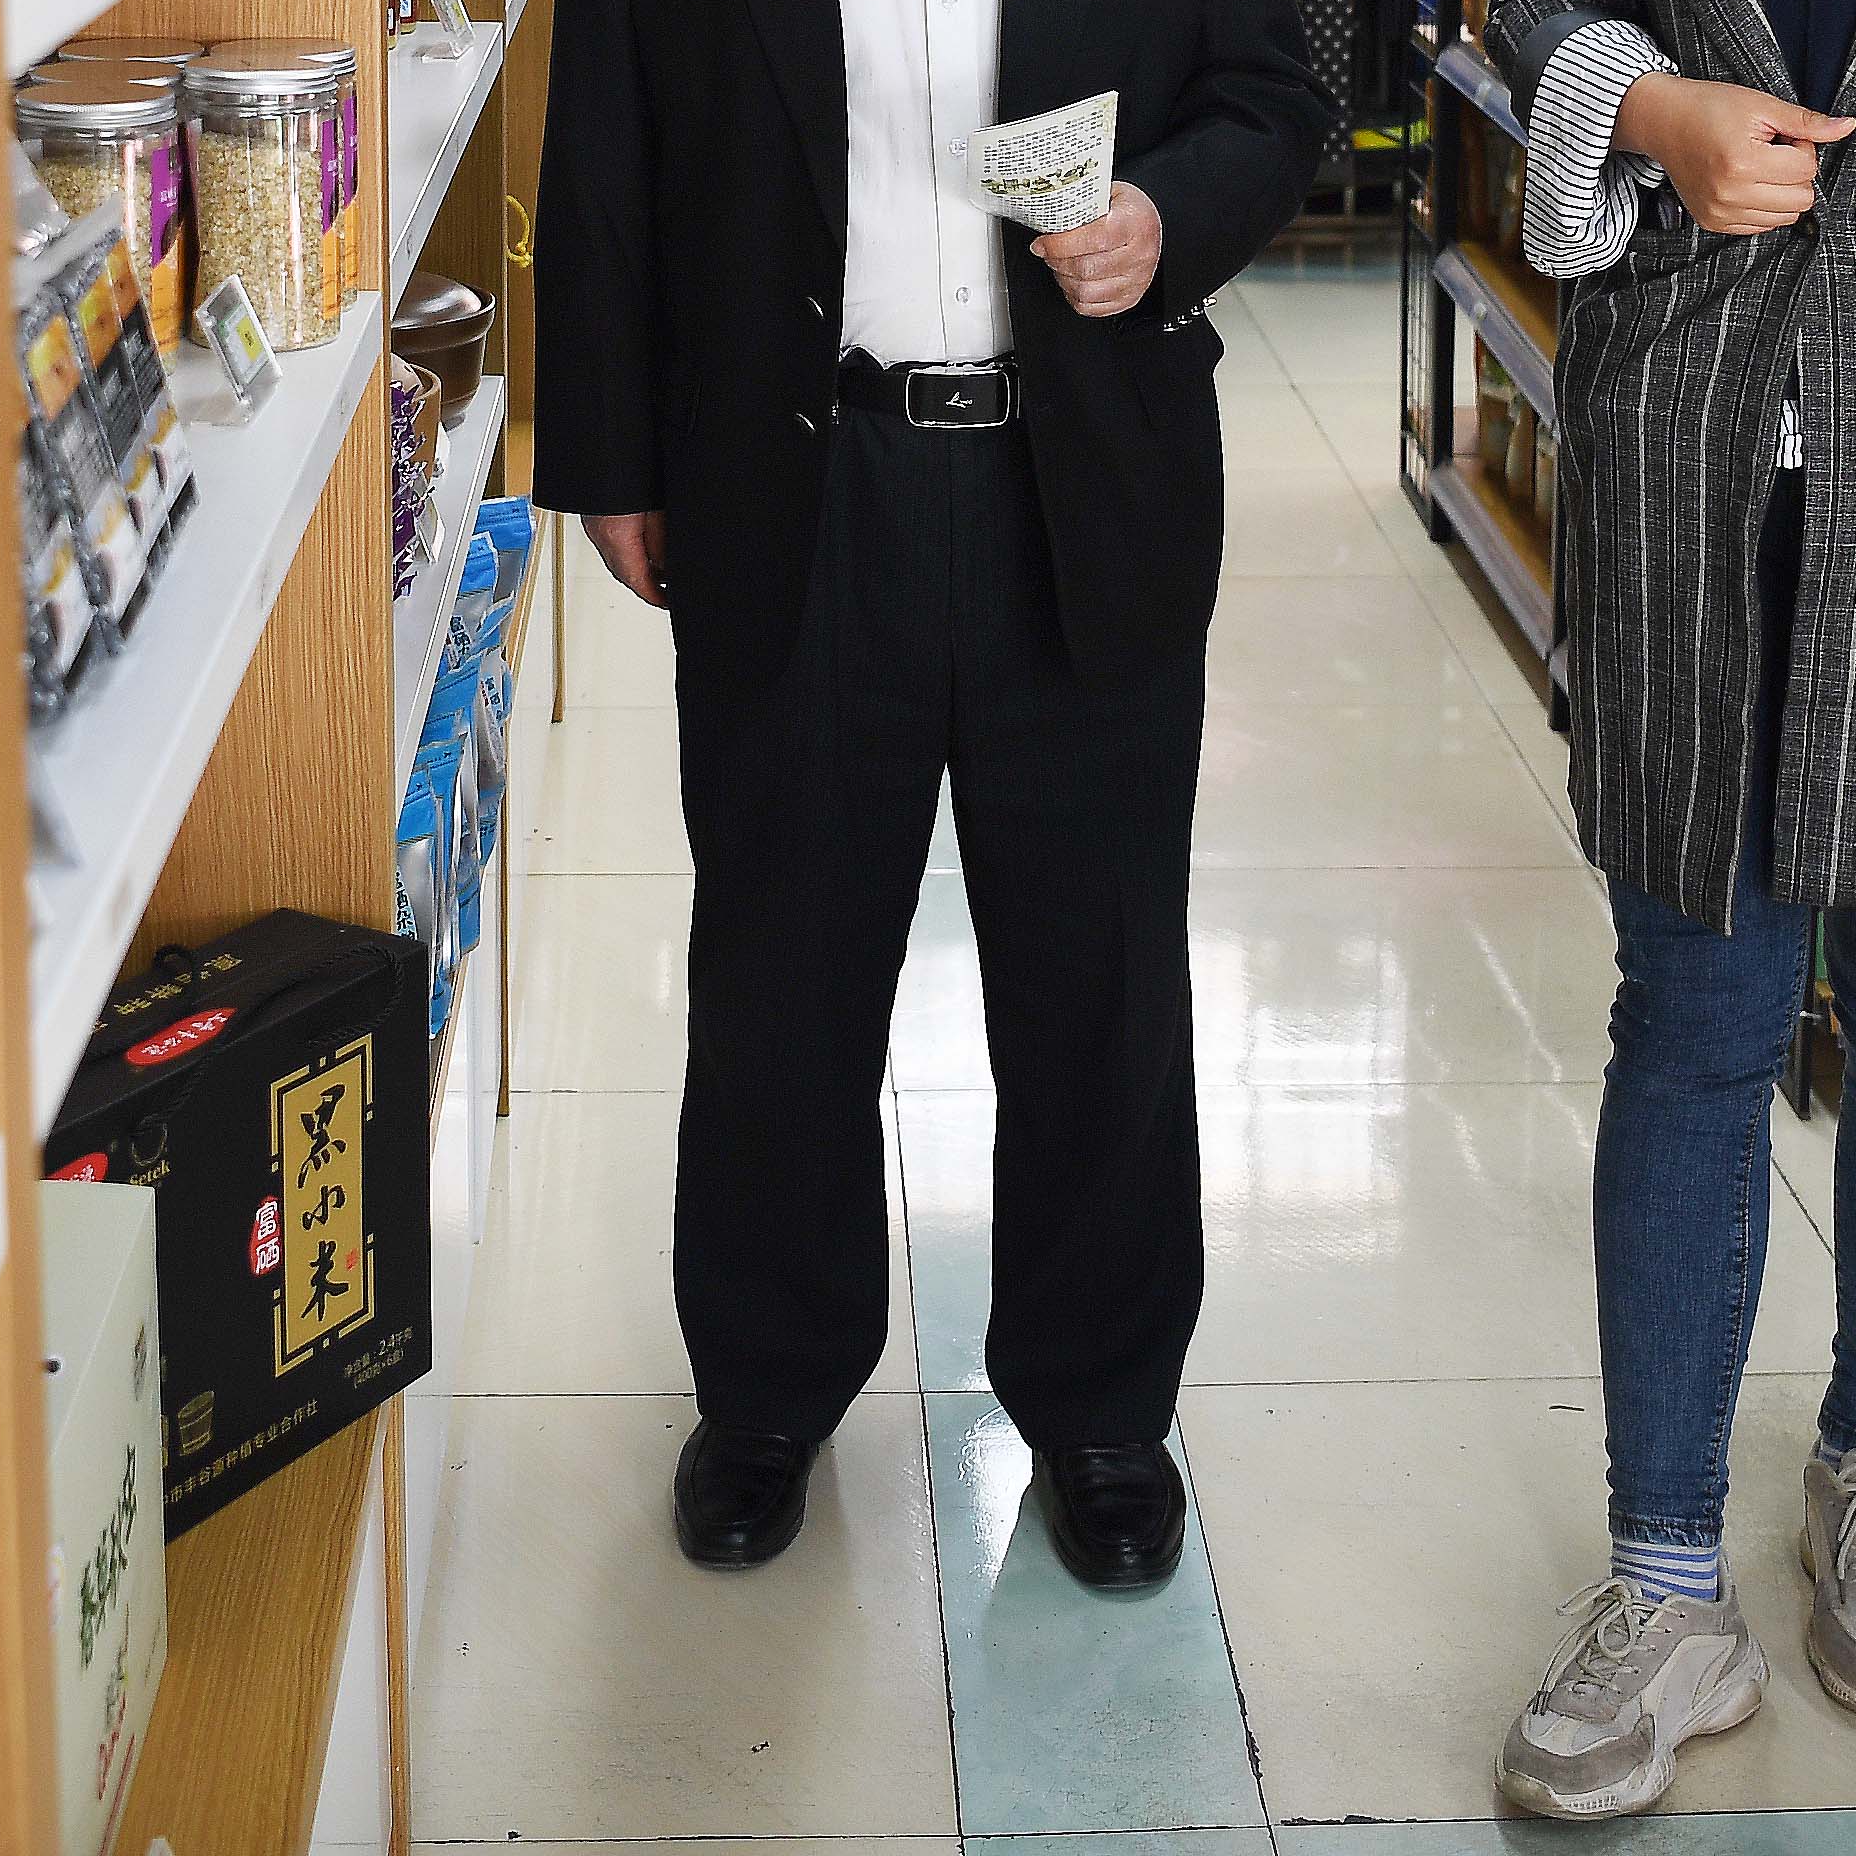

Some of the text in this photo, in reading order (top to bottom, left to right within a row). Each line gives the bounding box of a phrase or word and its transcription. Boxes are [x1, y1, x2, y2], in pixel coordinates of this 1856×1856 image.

[255, 1200, 281, 1274] 富硒
[296, 1082, 350, 1322] 黑小米
